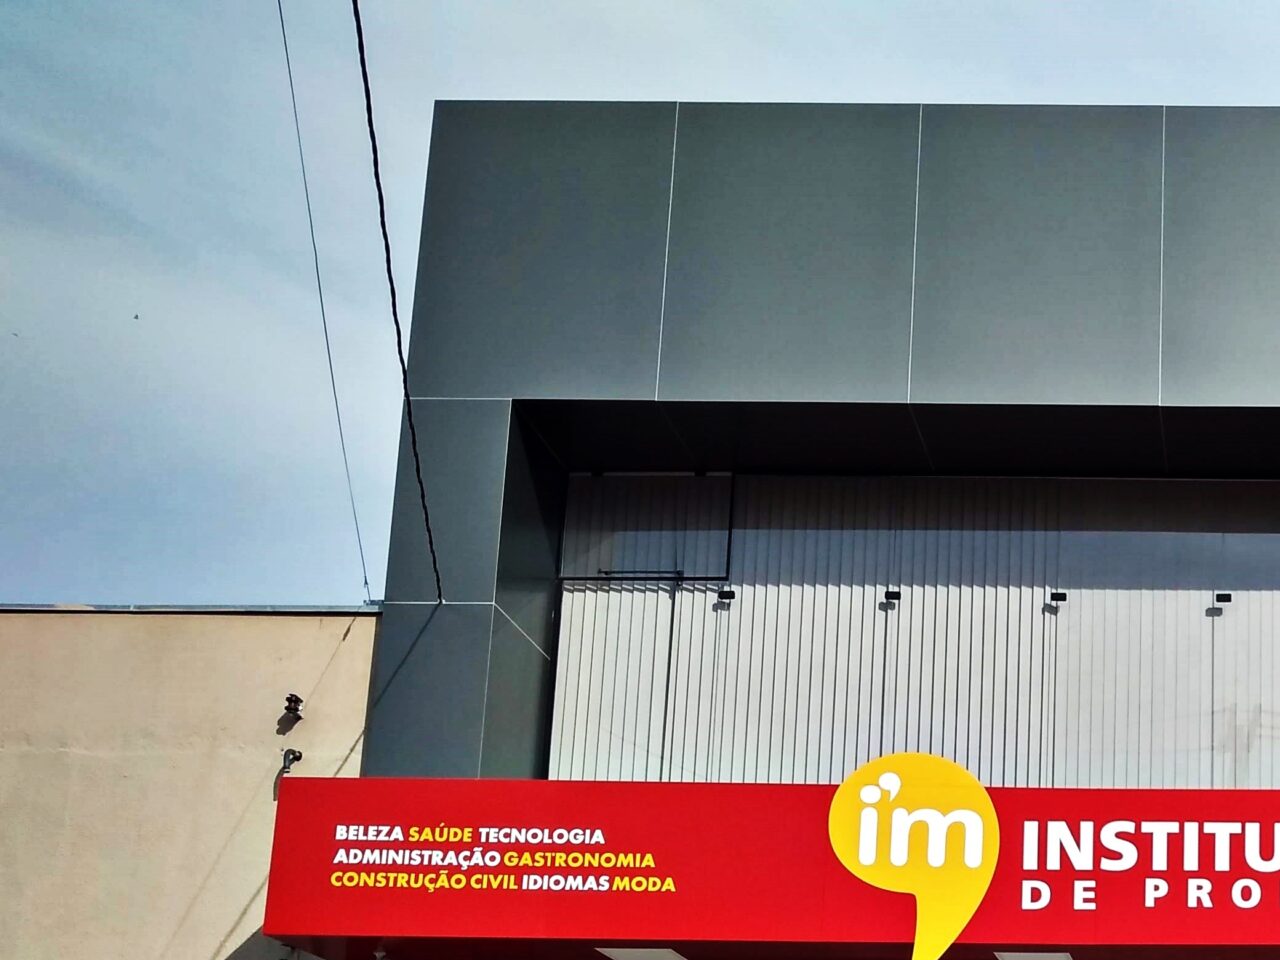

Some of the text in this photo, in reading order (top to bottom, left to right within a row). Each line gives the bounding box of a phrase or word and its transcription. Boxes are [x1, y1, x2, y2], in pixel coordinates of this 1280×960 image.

[335, 823, 605, 845] BELEZA SAÚDE TECNOLOGIA
[333, 847, 655, 870] ADMINISTRAÇÃO GASTRONOMIA
[331, 869, 676, 894] CONSTRUÇÃO CIVIL IDIOMAS MODA
[1021, 879, 1096, 910] DE
